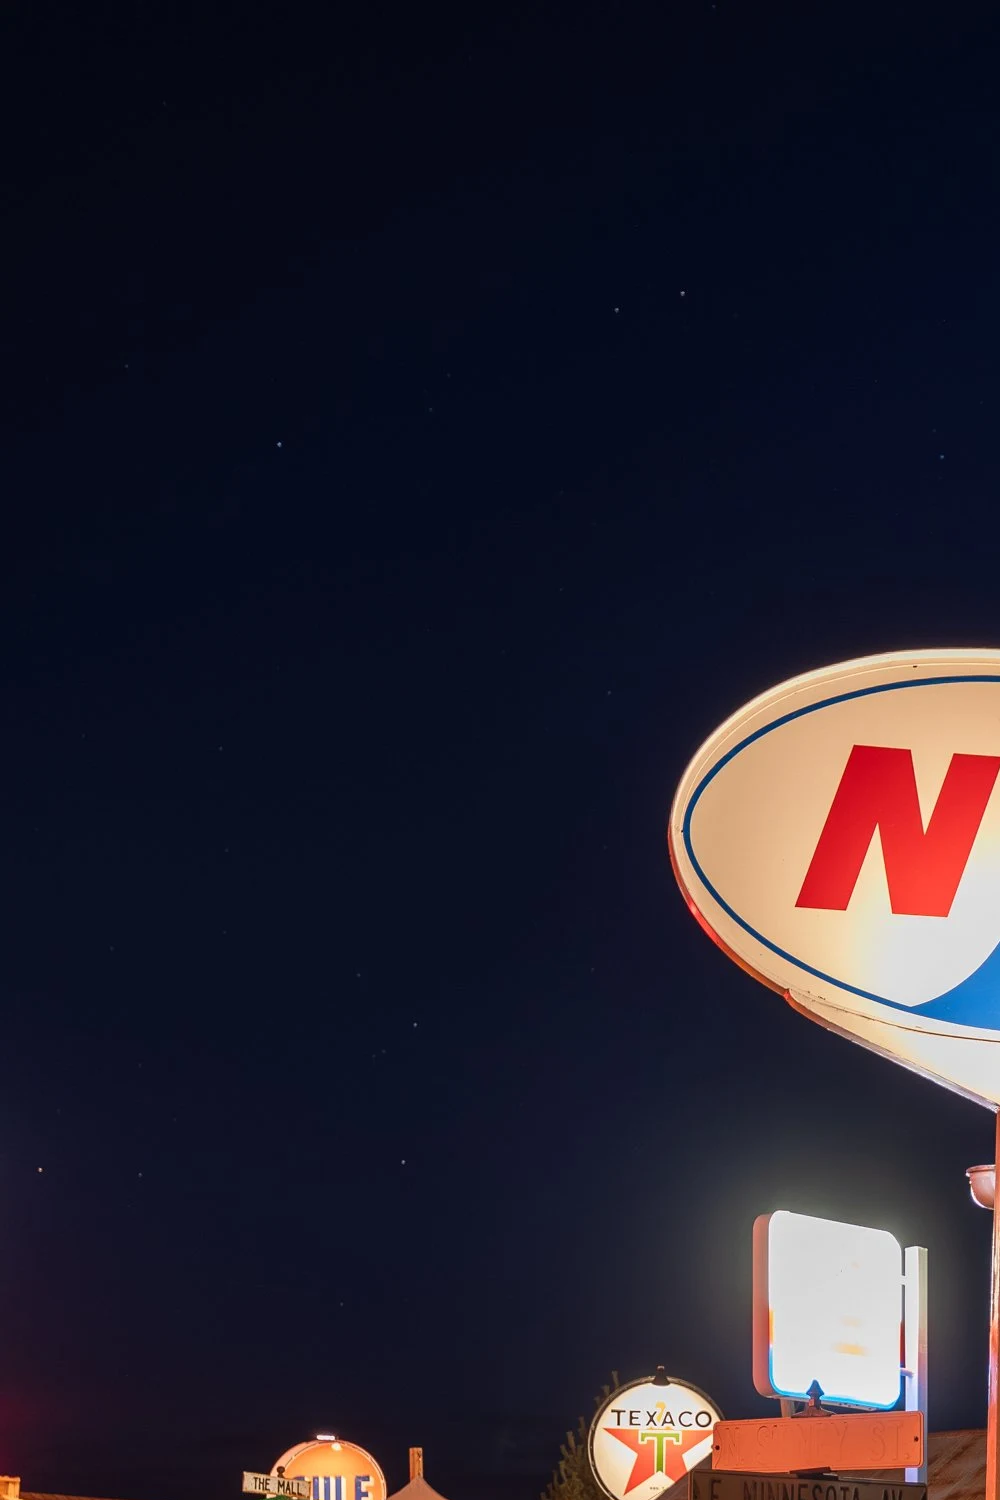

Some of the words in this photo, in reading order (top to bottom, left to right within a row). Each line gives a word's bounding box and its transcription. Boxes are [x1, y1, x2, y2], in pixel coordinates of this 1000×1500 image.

[611, 1409, 712, 1427] TEXACO
[641, 1432, 680, 1472] T
[253, 1476, 271, 1492] THE
[277, 1479, 304, 1497] MALL
